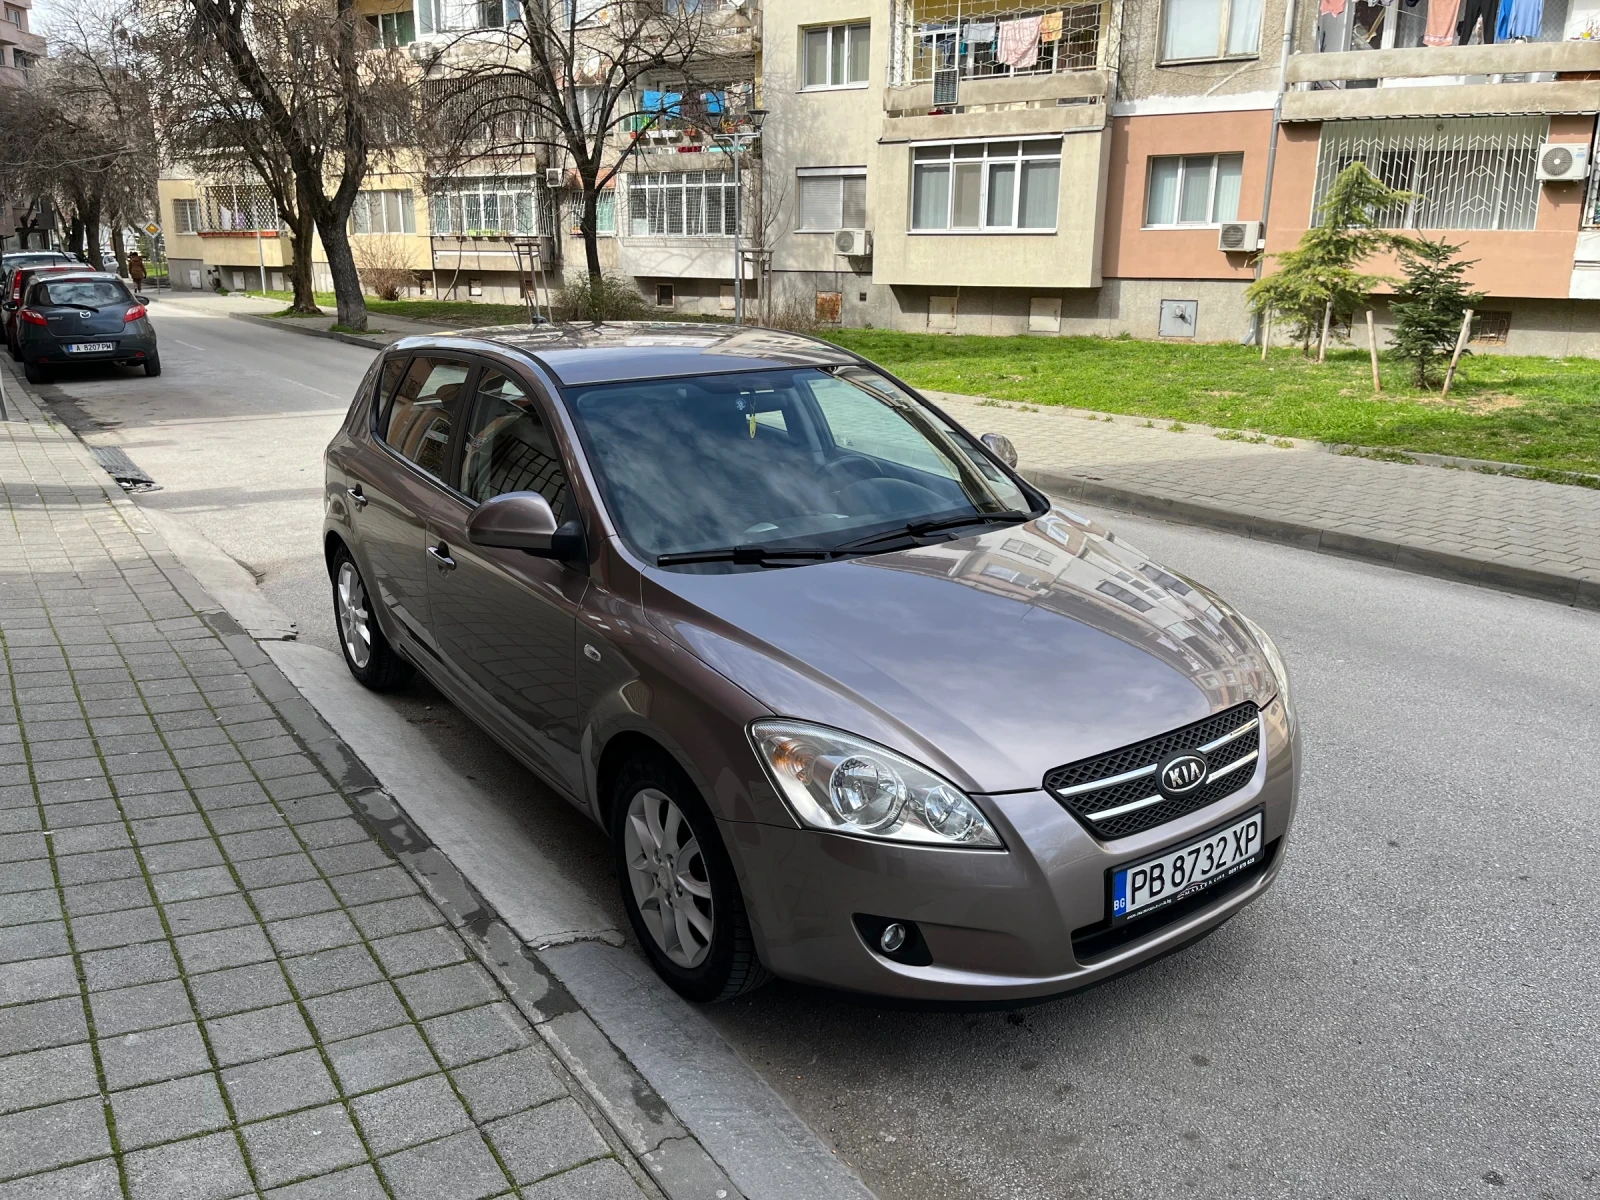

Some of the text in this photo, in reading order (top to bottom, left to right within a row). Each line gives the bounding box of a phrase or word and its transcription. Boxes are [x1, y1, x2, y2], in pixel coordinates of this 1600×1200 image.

[1168, 762, 1201, 787] KIA
[1131, 821, 1258, 905] PB 8732 XP
[1114, 897, 1125, 910] BG
